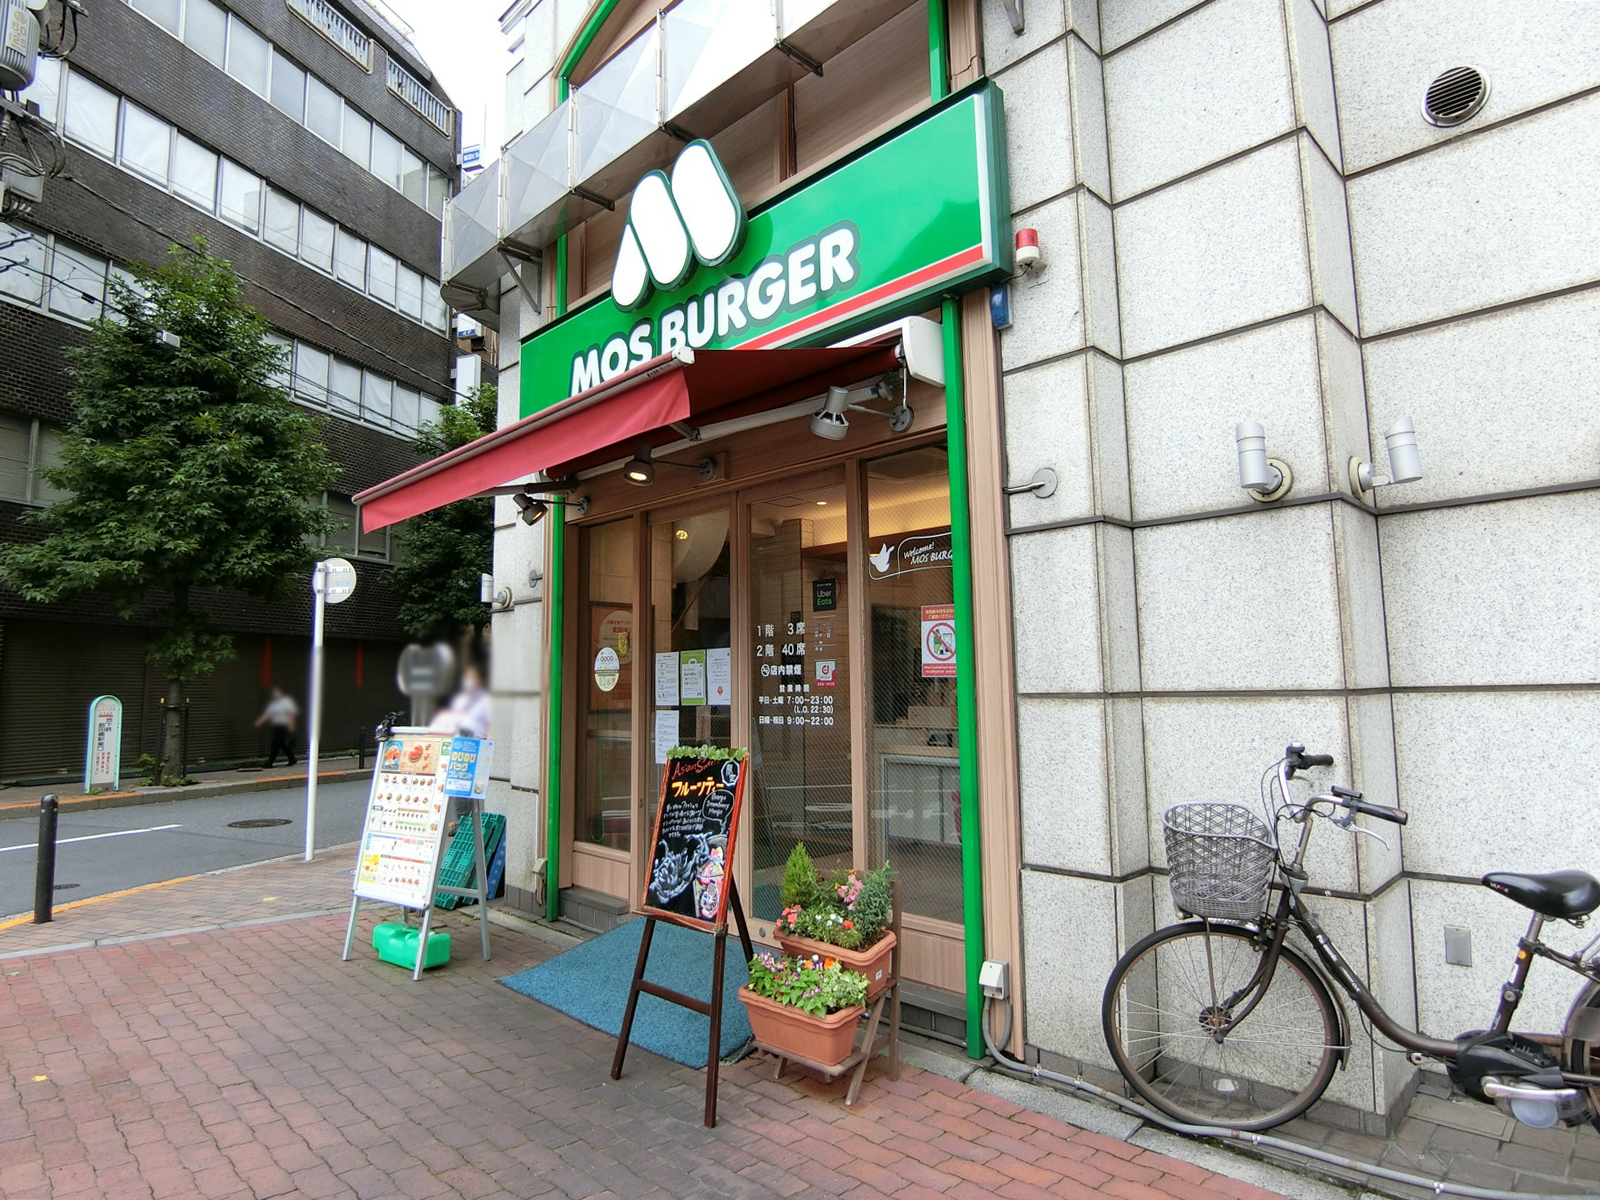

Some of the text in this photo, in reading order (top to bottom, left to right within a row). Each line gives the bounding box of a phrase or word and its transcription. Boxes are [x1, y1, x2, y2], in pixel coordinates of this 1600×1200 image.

[570, 227, 857, 398] MOS BURGER
[903, 541, 935, 560] Welcome!
[910, 549, 953, 565] MOS BURG
[816, 588, 832, 598] Uber
[816, 598, 833, 606] Eats
[770, 664, 802, 676] 店内禁煙
[779, 684, 810, 693] 営業時間
[672, 776, 724, 797] フルーツティー
